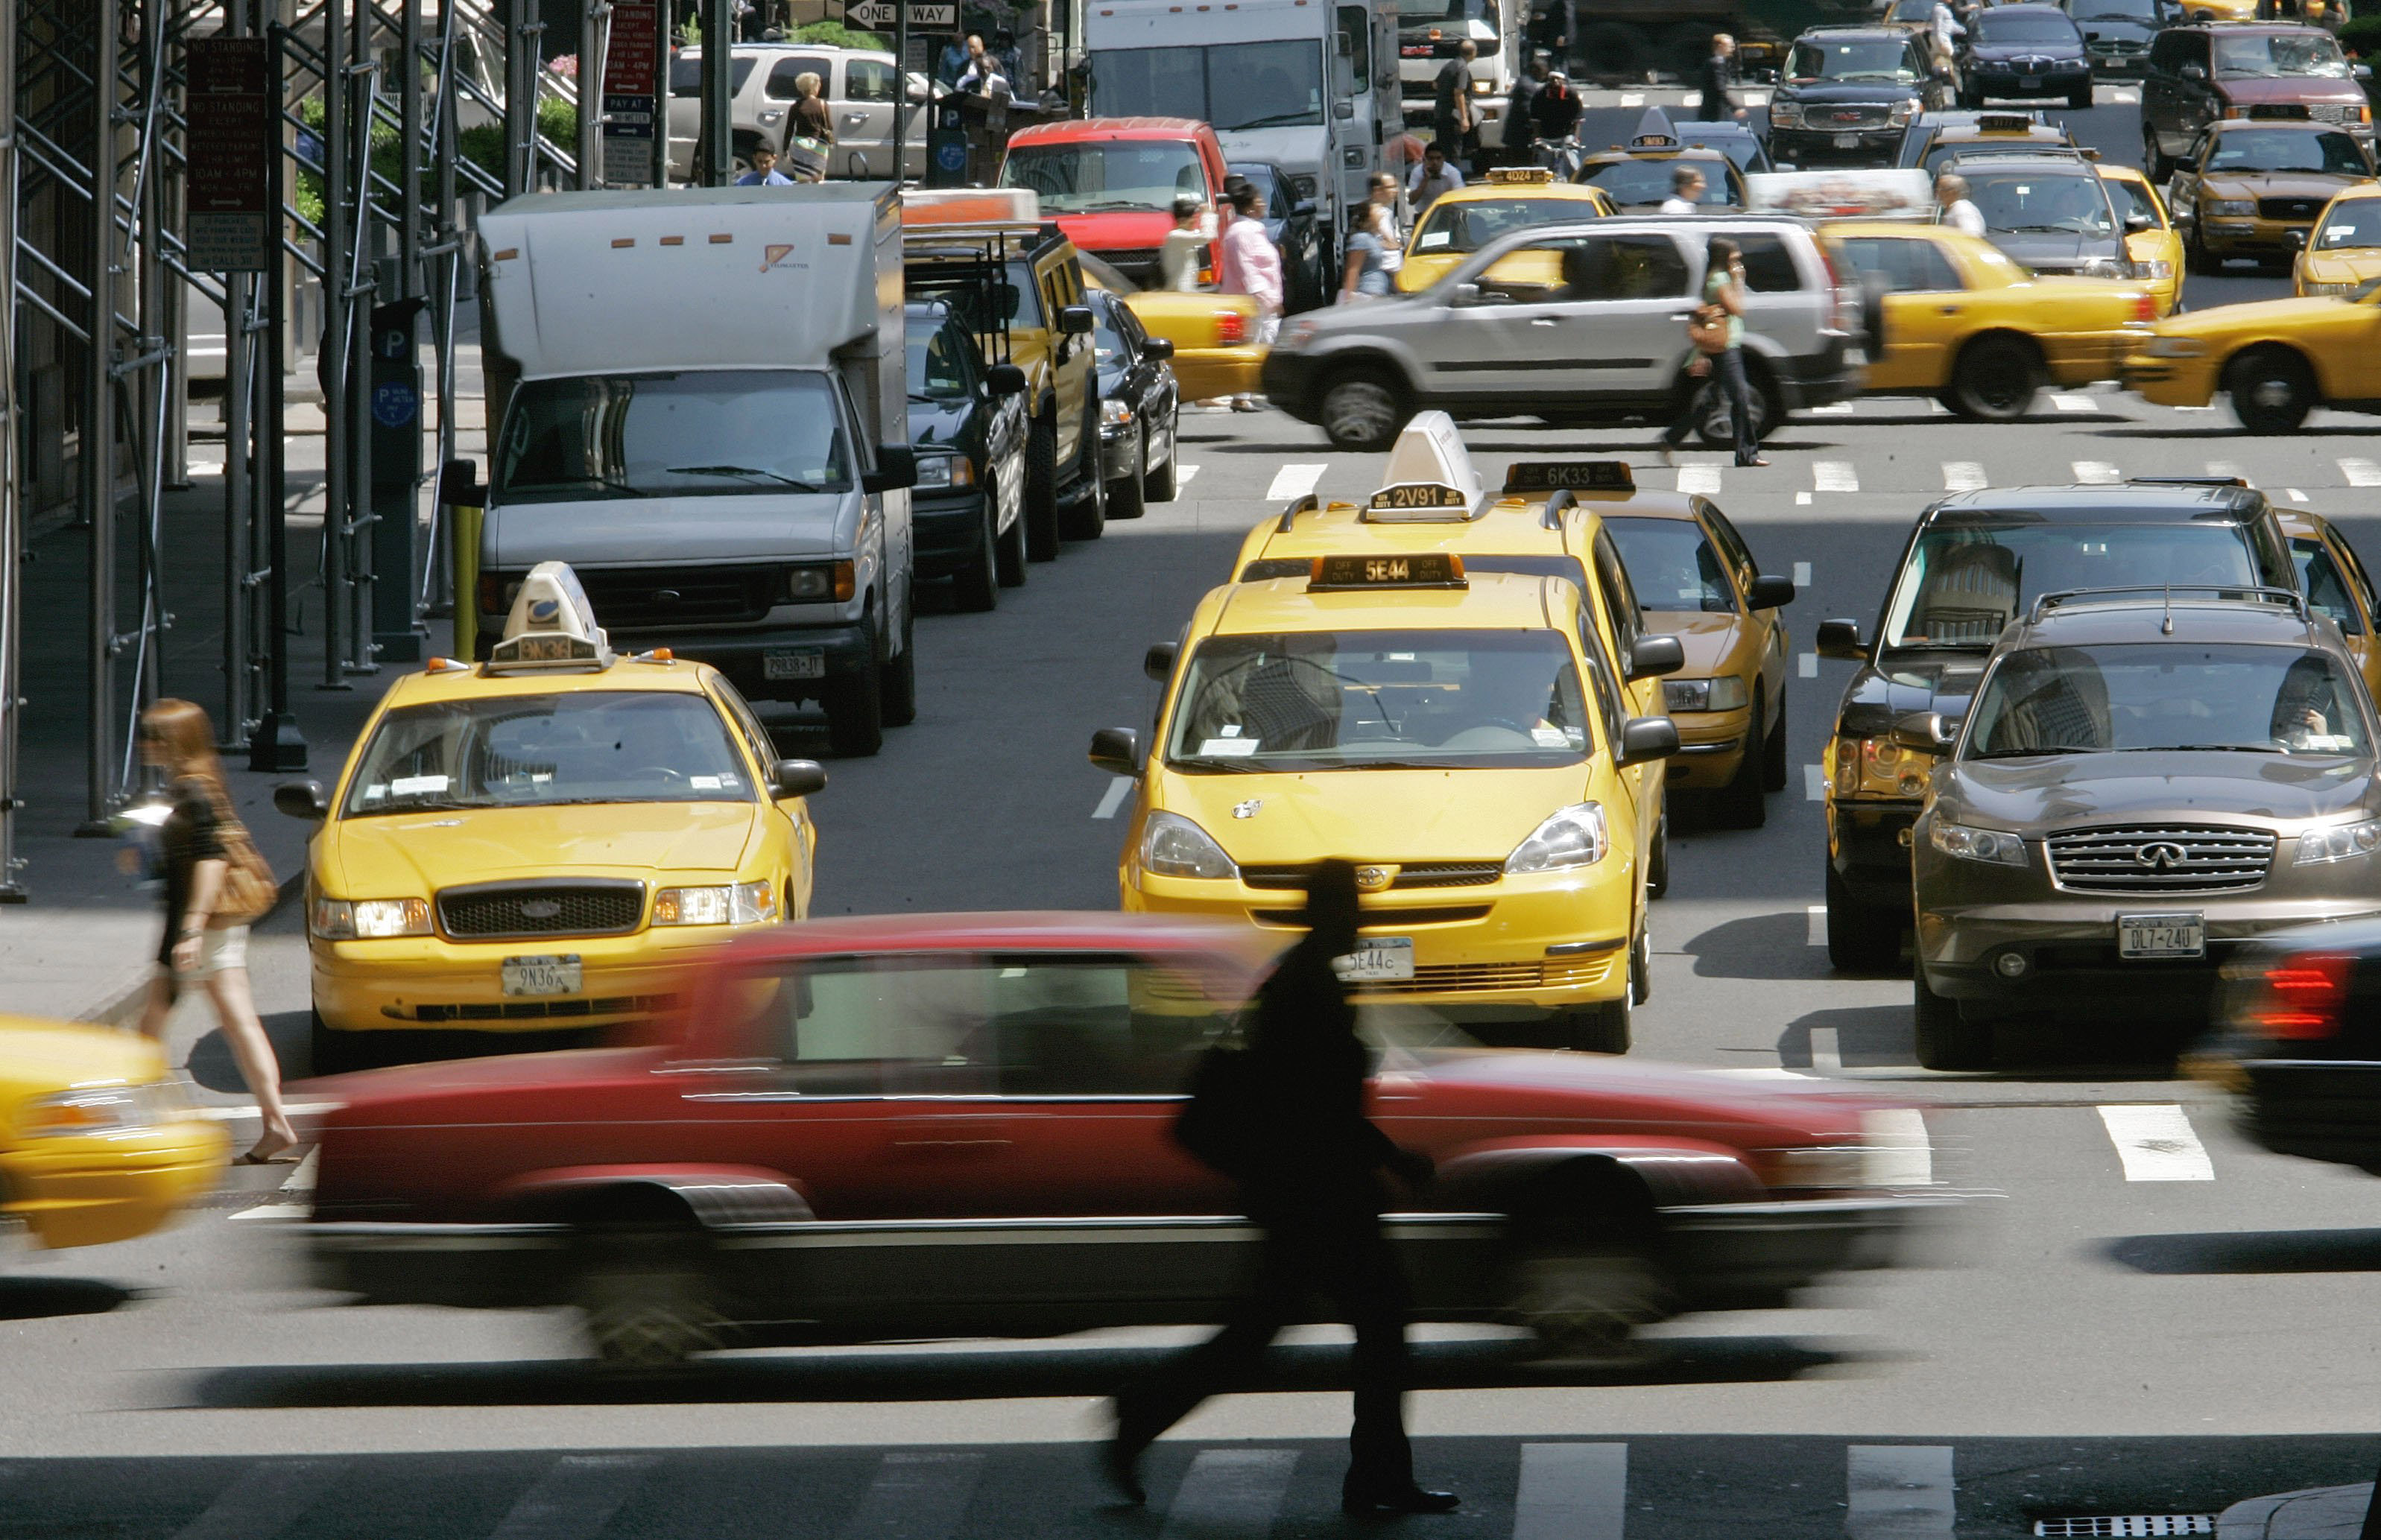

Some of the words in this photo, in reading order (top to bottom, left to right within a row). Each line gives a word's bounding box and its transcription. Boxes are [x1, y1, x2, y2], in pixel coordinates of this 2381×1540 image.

[616, 10, 652, 20] STANDING
[860, 6, 891, 21] ONE
[913, 6, 946, 22] WAY
[192, 42, 206, 53] NO
[212, 41, 259, 53] STANDING
[633, 60, 649, 70] 4PM
[192, 102, 206, 113] NO
[209, 101, 259, 113] STANDING
[610, 98, 628, 108] PAY
[631, 98, 642, 108] AT
[946, 110, 958, 127] P
[195, 168, 221, 179] 10AM
[233, 168, 258, 179] 4PM
[1507, 171, 1531, 181] 4D24
[212, 256, 235, 265] CALL
[388, 329, 405, 358] P
[379, 389, 389, 403] P
[1547, 467, 1590, 485] 6K33
[1396, 488, 1438, 507] 2V91
[1335, 561, 1353, 571] OFF
[1422, 559, 1438, 568] OFF
[1365, 560, 1409, 581] 5E44
[1420, 569, 1442, 580] DUTY
[1332, 571, 1355, 582] DUTY
[522, 639, 569, 659] 9N36
